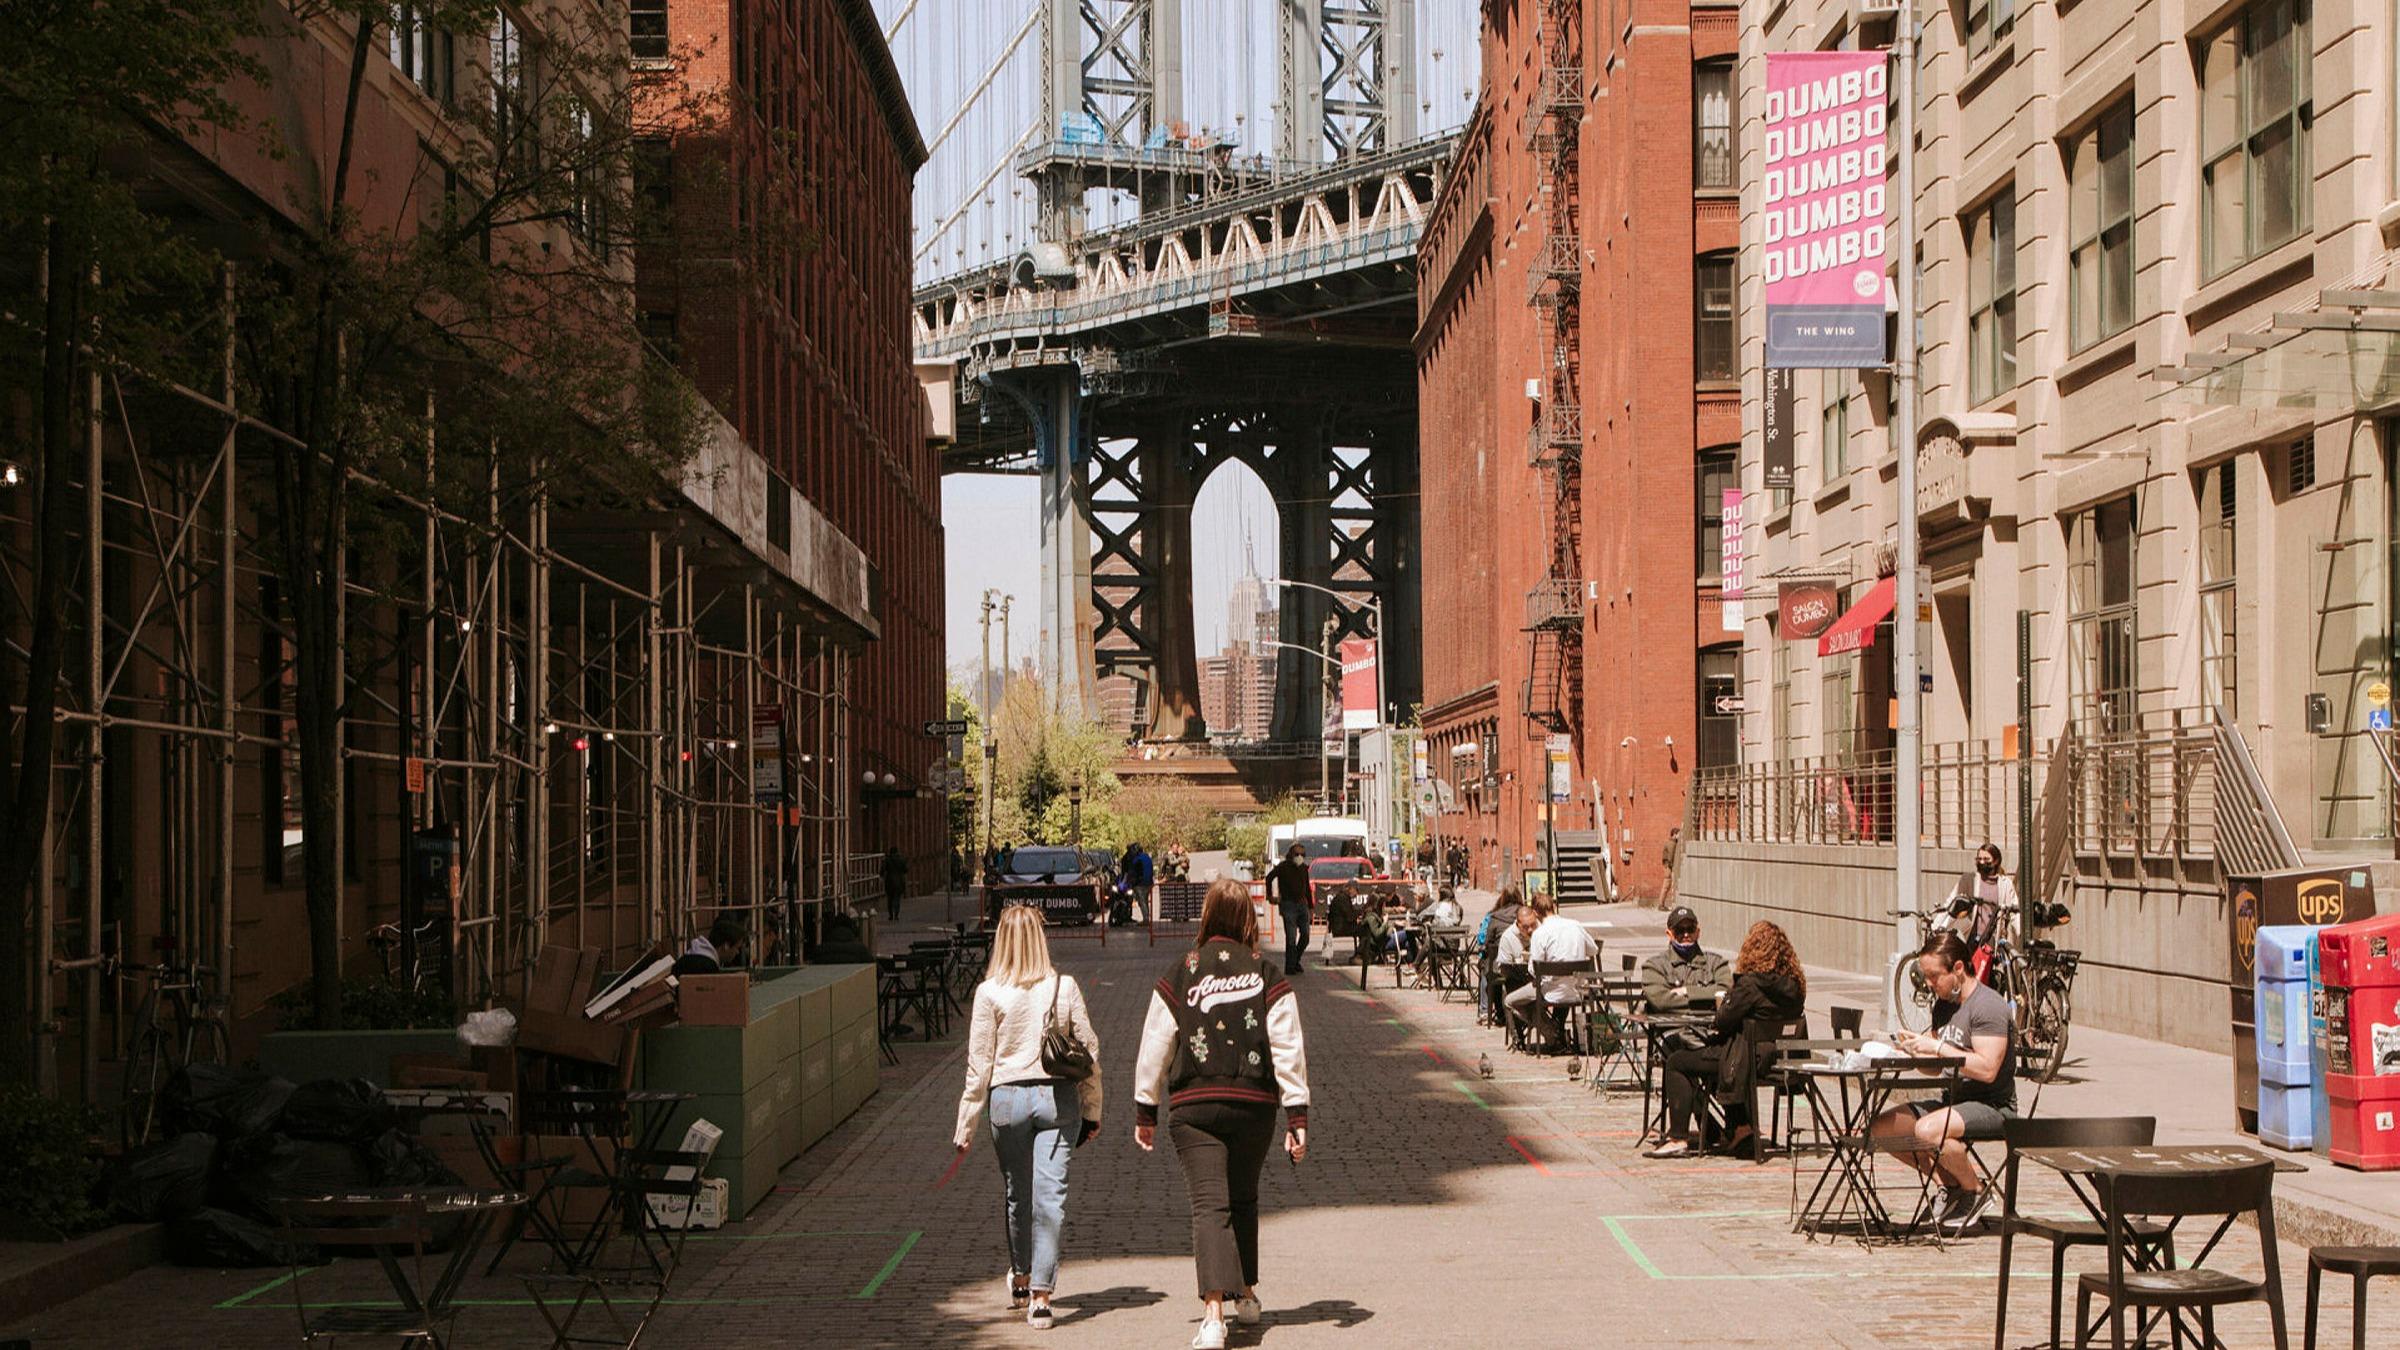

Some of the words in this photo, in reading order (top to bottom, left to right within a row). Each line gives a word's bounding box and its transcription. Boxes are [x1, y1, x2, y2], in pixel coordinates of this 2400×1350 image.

[1766, 64, 1887, 126] DUMBO
[1765, 103, 1886, 165] DUMBO
[1765, 143, 1886, 205] DUMBO
[1765, 184, 1886, 244] DUMBO
[1765, 224, 1886, 284] DUMBO
[1797, 326, 1818, 336] THE
[1824, 326, 1856, 336] WING
[1342, 656, 1376, 675] DUMBO
[2302, 895, 2341, 924] ups
[1187, 972, 1263, 1007] Amour
